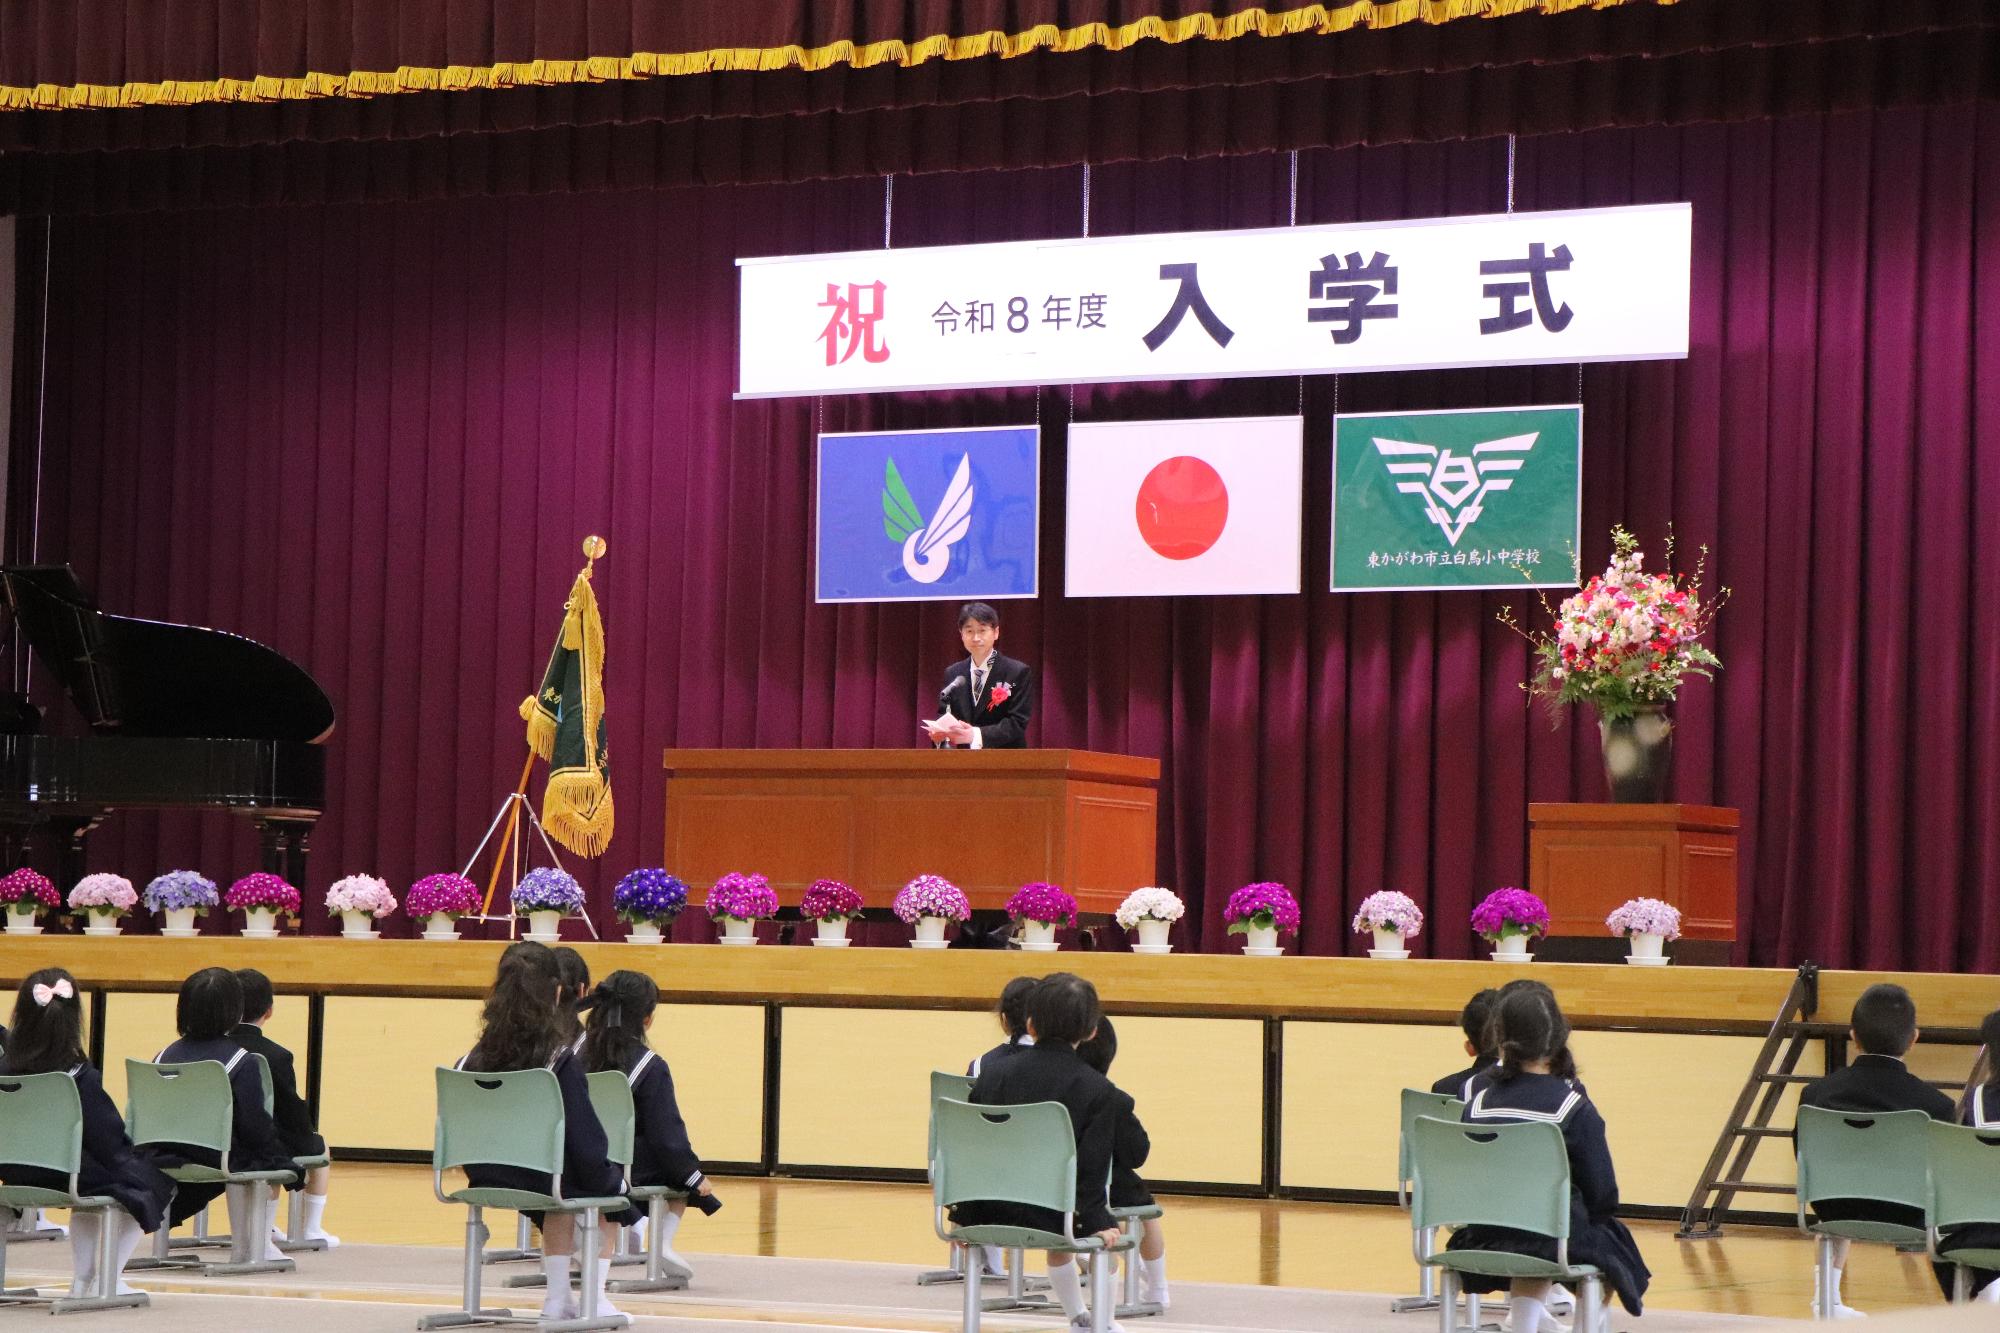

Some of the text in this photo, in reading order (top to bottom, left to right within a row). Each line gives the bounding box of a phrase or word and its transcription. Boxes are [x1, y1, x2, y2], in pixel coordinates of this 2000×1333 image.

[817, 243, 1575, 367] 祝 令和8年度 入学式
[1367, 548, 1542, 568] 東かがわ市立白鳥小中学校
